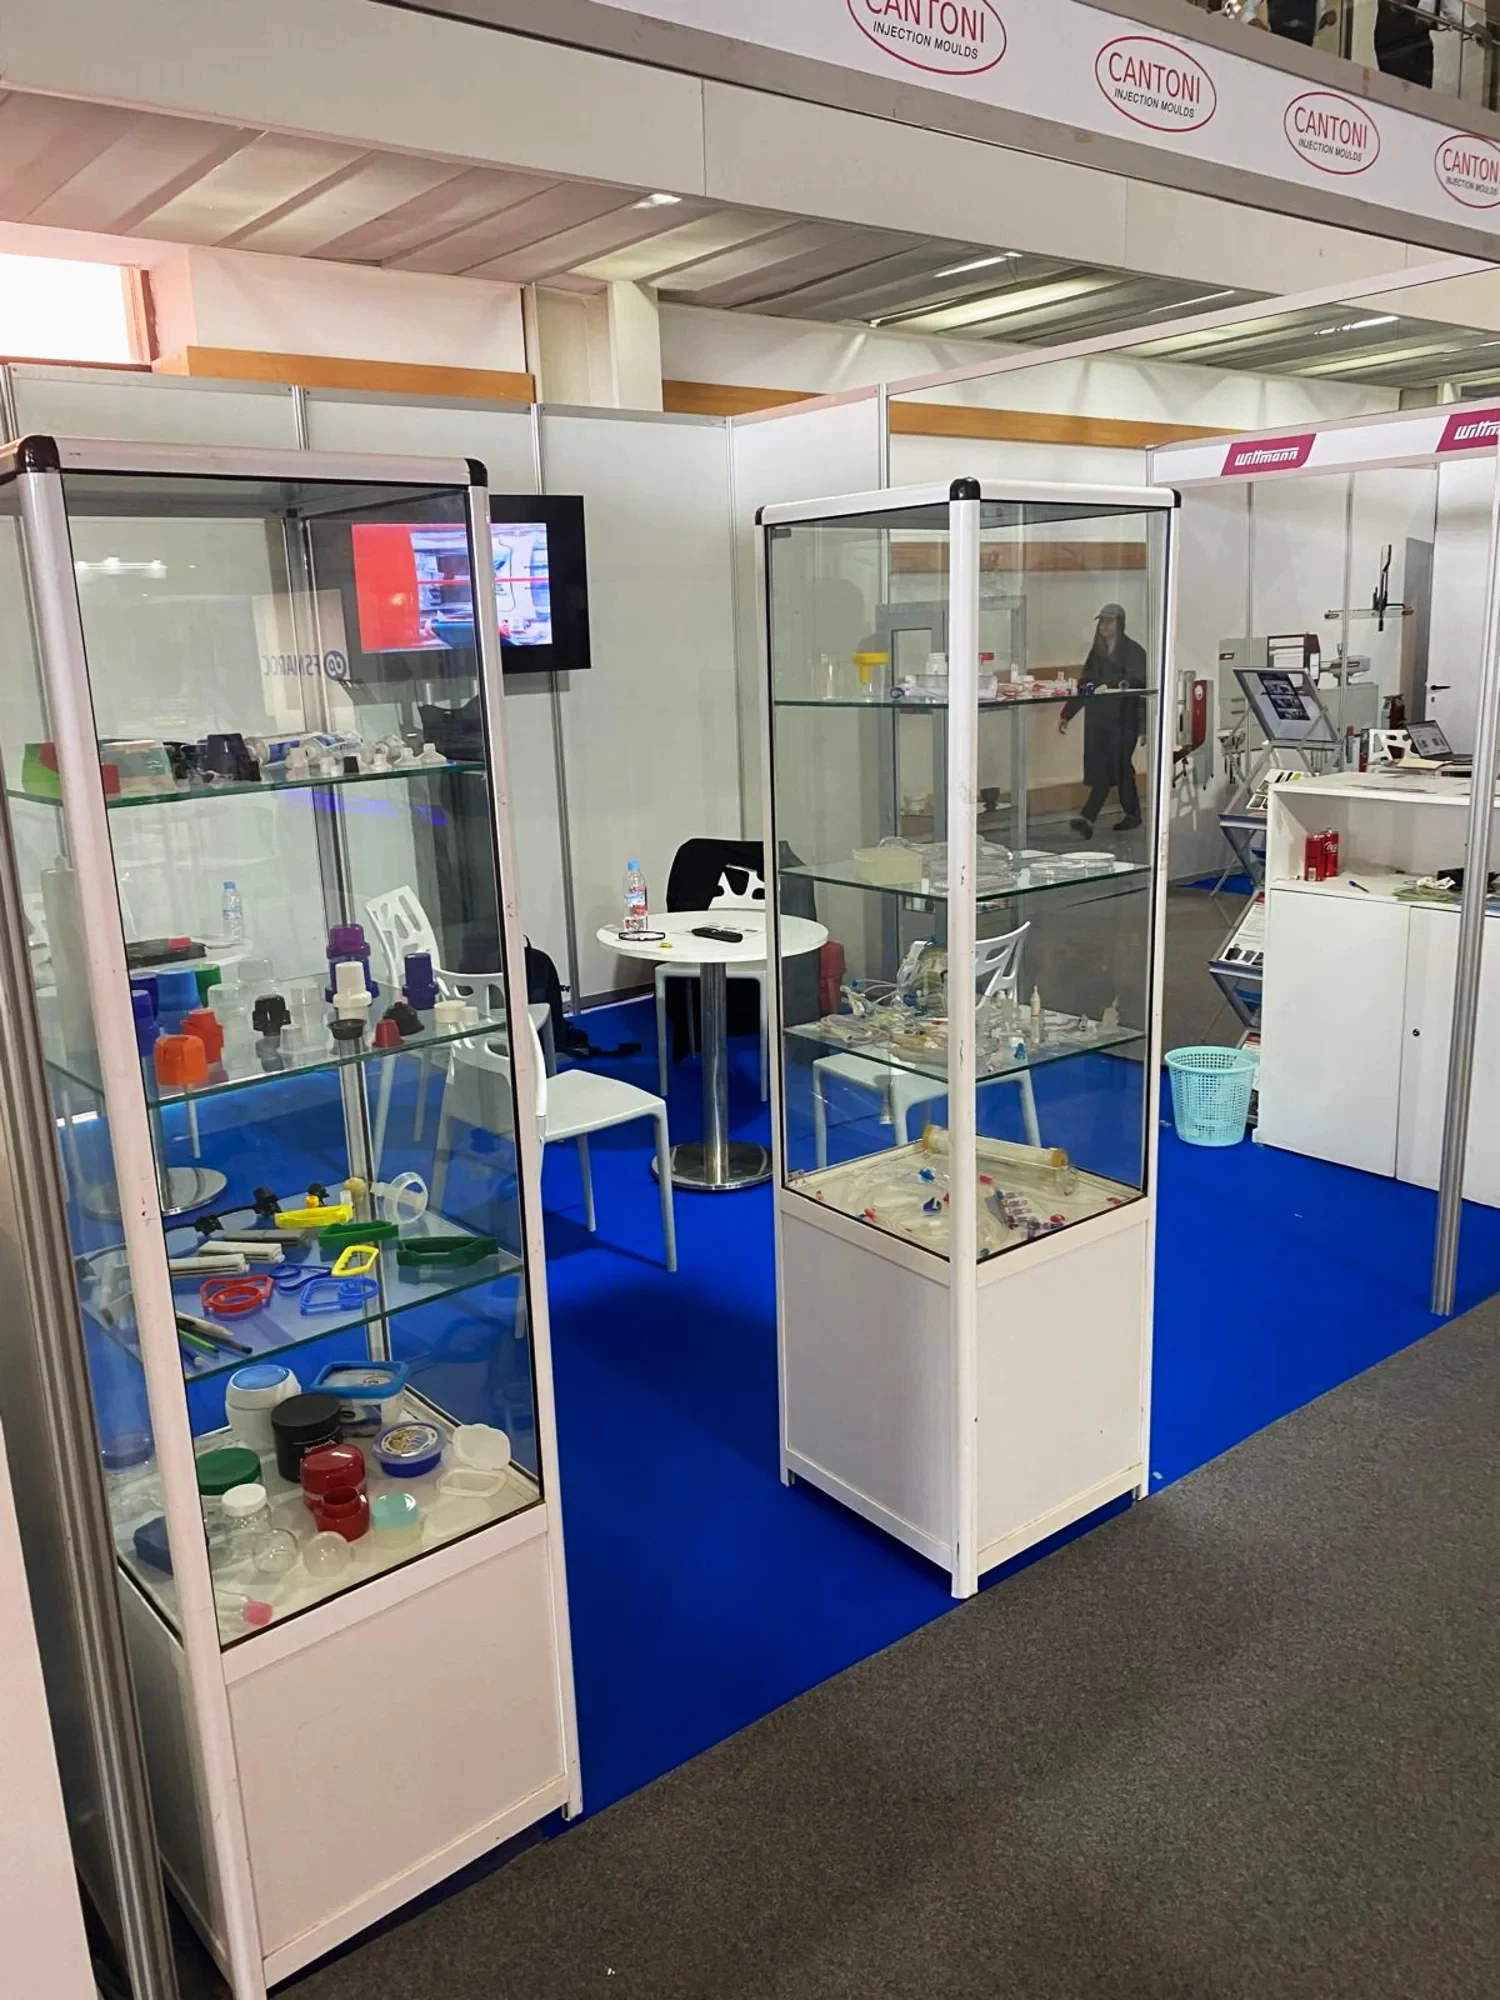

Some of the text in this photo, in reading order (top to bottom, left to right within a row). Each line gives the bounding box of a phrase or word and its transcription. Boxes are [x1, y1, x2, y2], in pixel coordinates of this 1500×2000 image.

[873, 21, 979, 60] INJECTION MOULDS
[1108, 51, 1200, 104] CANTONI
[1114, 87, 1195, 118] INJECTION MOULDS
[1294, 106, 1367, 149] CANTONI
[1298, 138, 1362, 162] INJECTION MOULDS
[1443, 148, 1500, 184] CANTON
